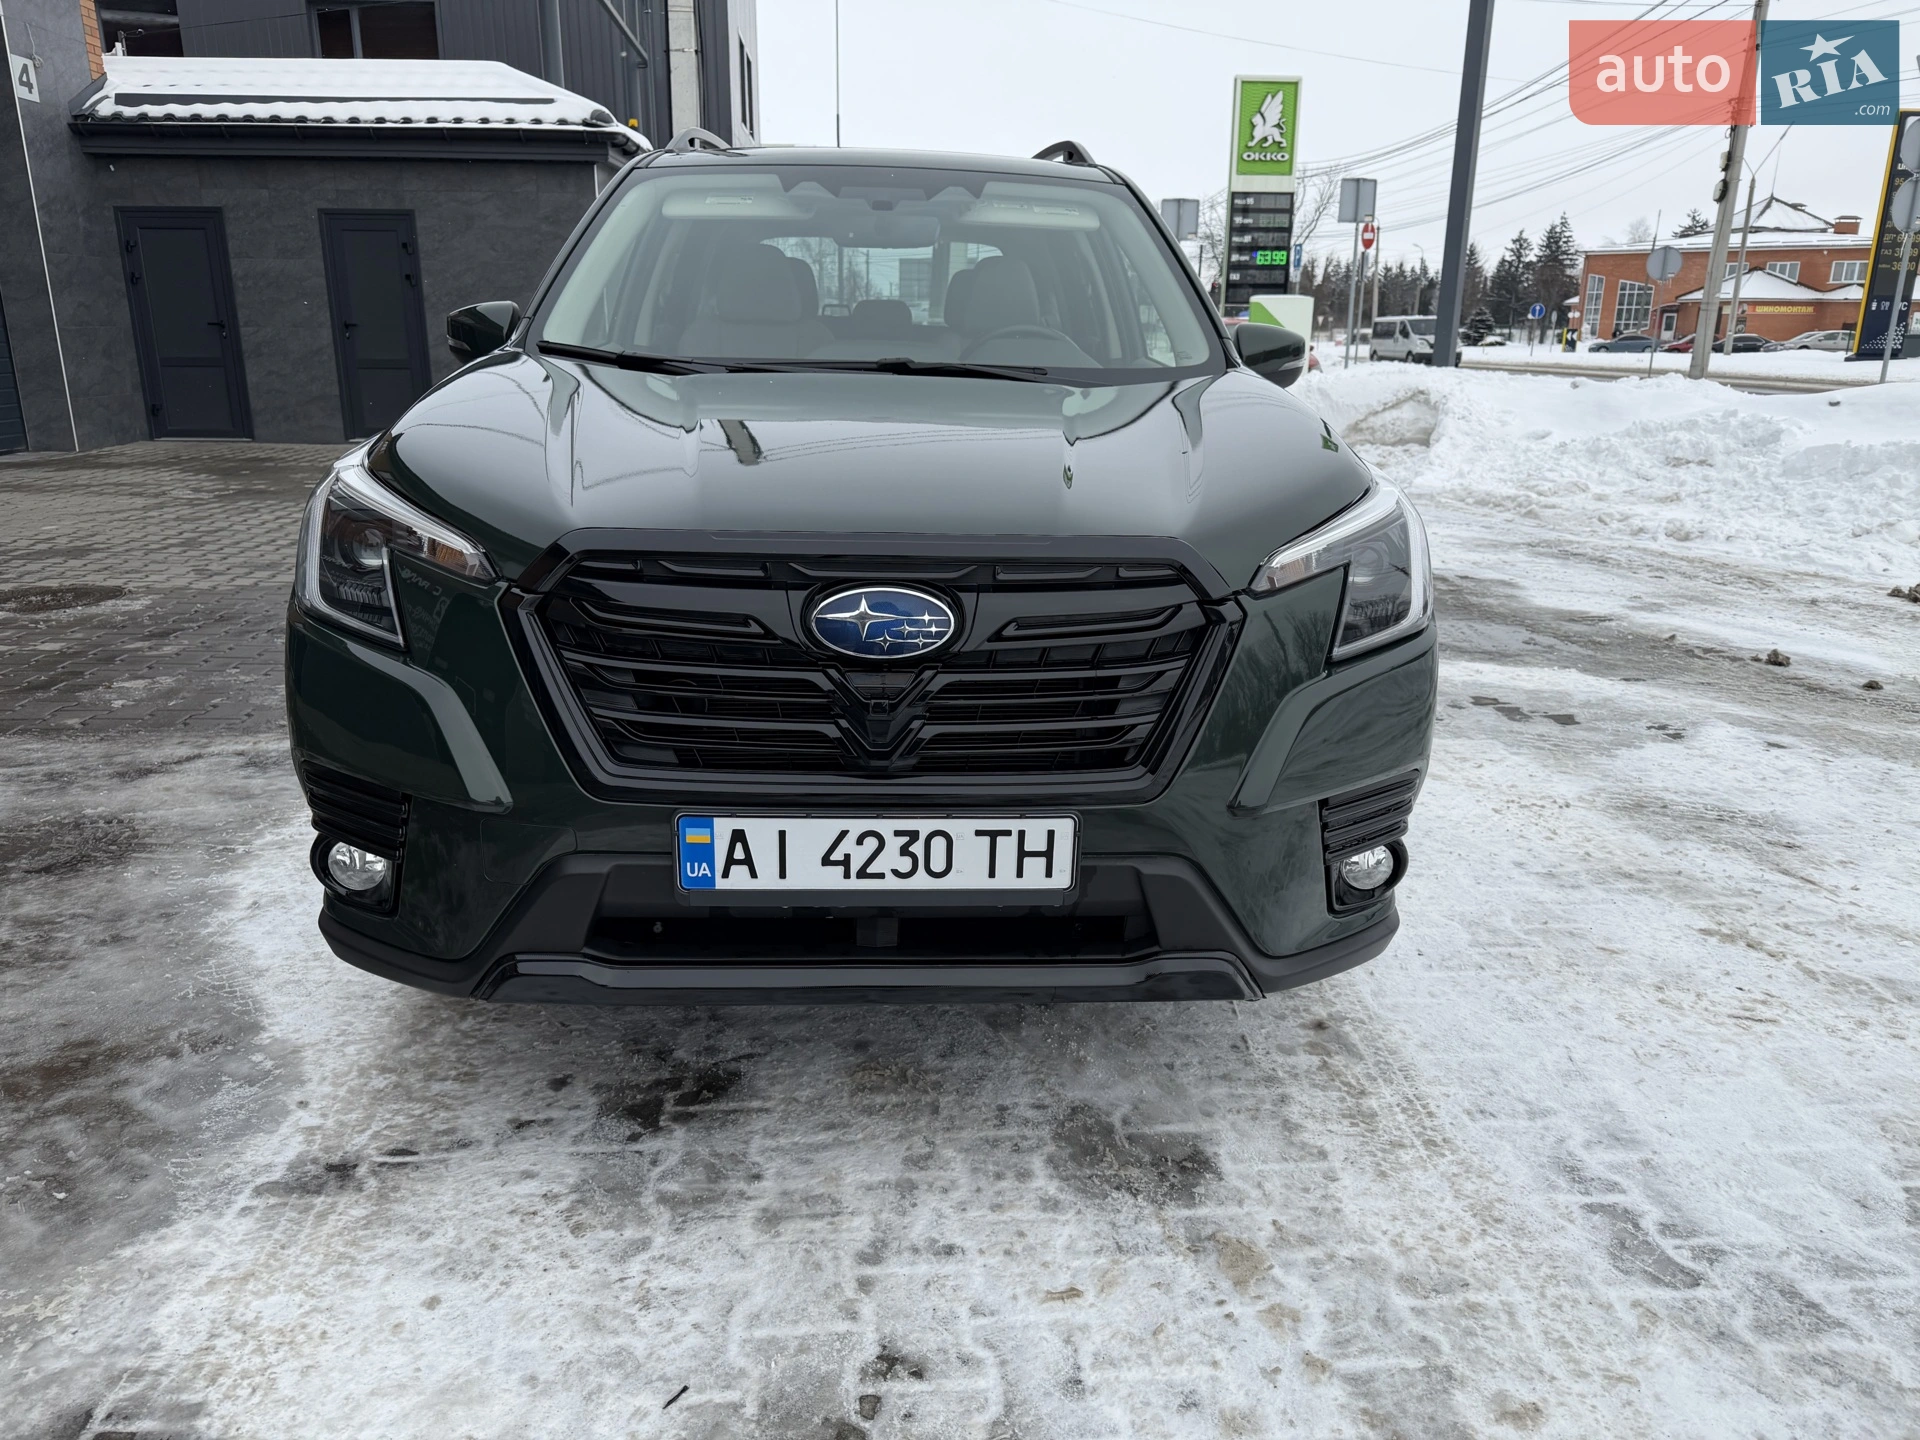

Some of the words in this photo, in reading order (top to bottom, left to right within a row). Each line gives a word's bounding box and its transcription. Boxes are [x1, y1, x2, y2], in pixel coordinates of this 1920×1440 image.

[18, 63, 34, 95] 4
[1242, 151, 1290, 161] OKKO
[1755, 305, 1815, 313] ШИНОМОНТАЖ
[821, 829, 954, 879] 4230
[974, 829, 1055, 879] TH
[686, 862, 711, 877] UA
